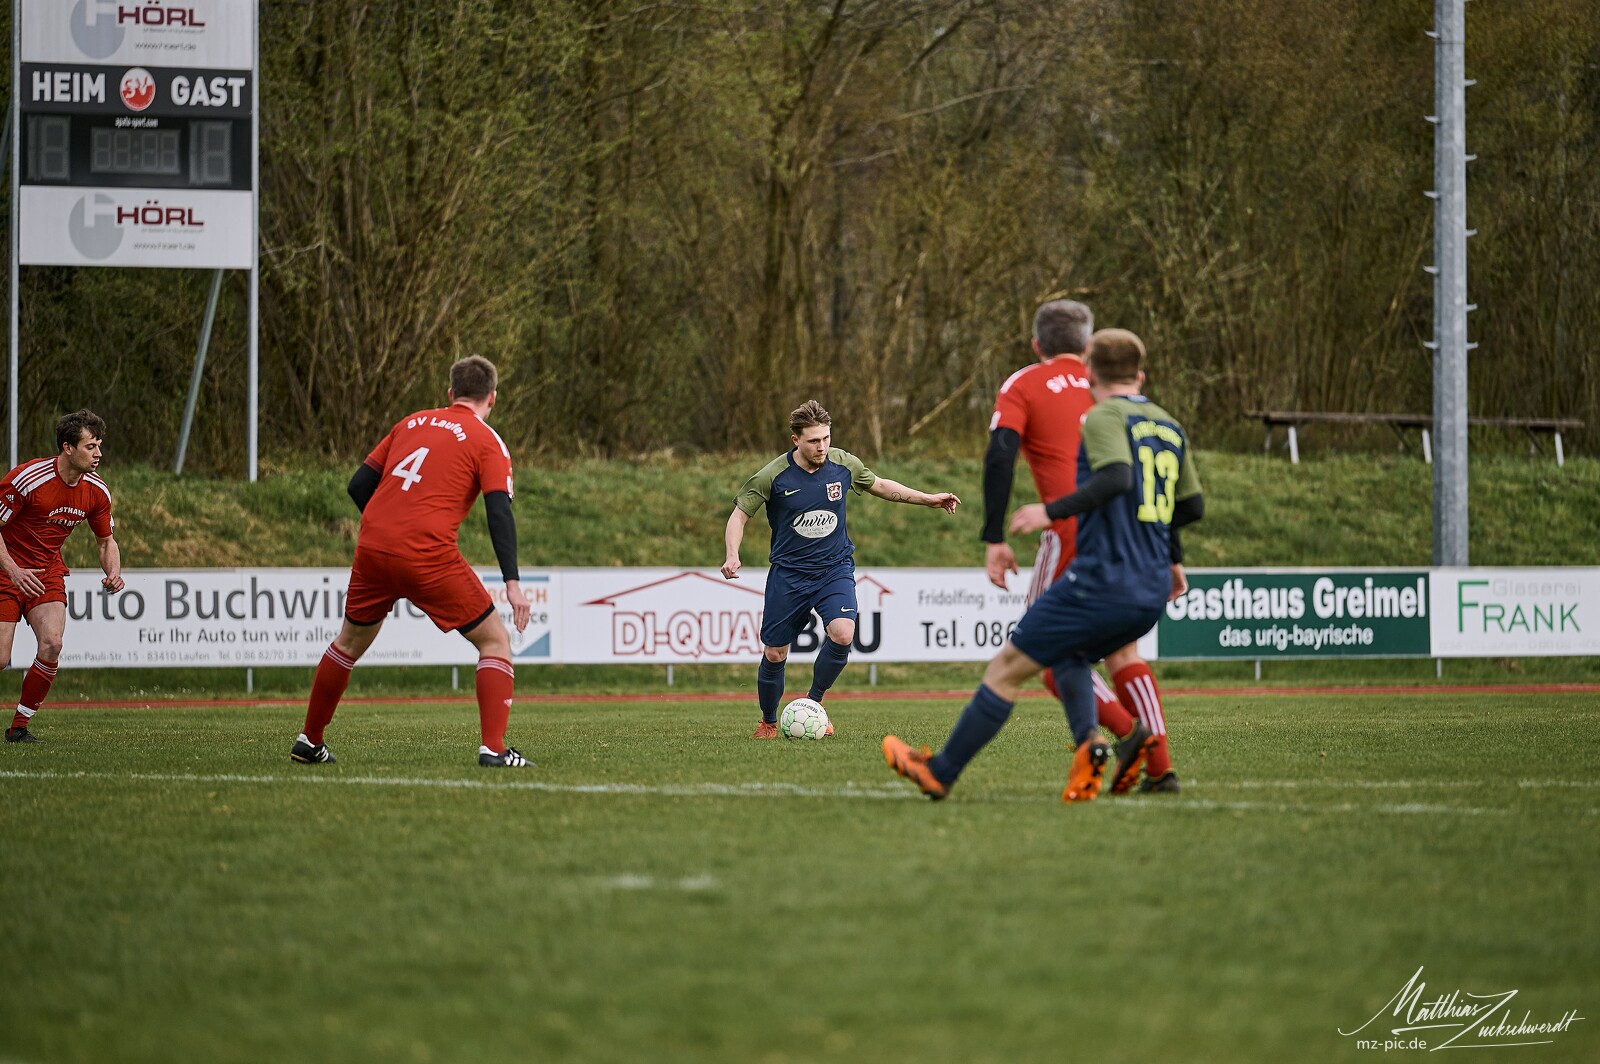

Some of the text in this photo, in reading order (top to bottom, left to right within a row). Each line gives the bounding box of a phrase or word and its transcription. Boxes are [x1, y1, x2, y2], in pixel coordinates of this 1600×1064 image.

[118, 0, 206, 27] HÖRL
[32, 71, 106, 103] HEIM
[170, 76, 246, 107] GAST
[117, 200, 205, 226] HÖRL
[407, 416, 467, 442] SV Laufen
[391, 446, 430, 492] 4
[1136, 445, 1179, 525] 13
[48, 506, 86, 518] GASTHAUS
[488, 587, 548, 604] BOCH
[918, 589, 985, 610] Fridolfing
[1165, 577, 1426, 621] Gasthaus Greimel
[1492, 579, 1582, 597] Glaserei
[67, 583, 145, 621] uto
[139, 627, 165, 643] Für
[170, 626, 192, 643] Ihr
[197, 628, 236, 644] Auto
[242, 629, 269, 643] tun
[274, 626, 300, 643] wir
[612, 610, 763, 658] DI-QUA
[921, 620, 965, 647] Tel.
[1218, 623, 1374, 651] das urig-bayrische
[179, 650, 210, 661] Laufen
